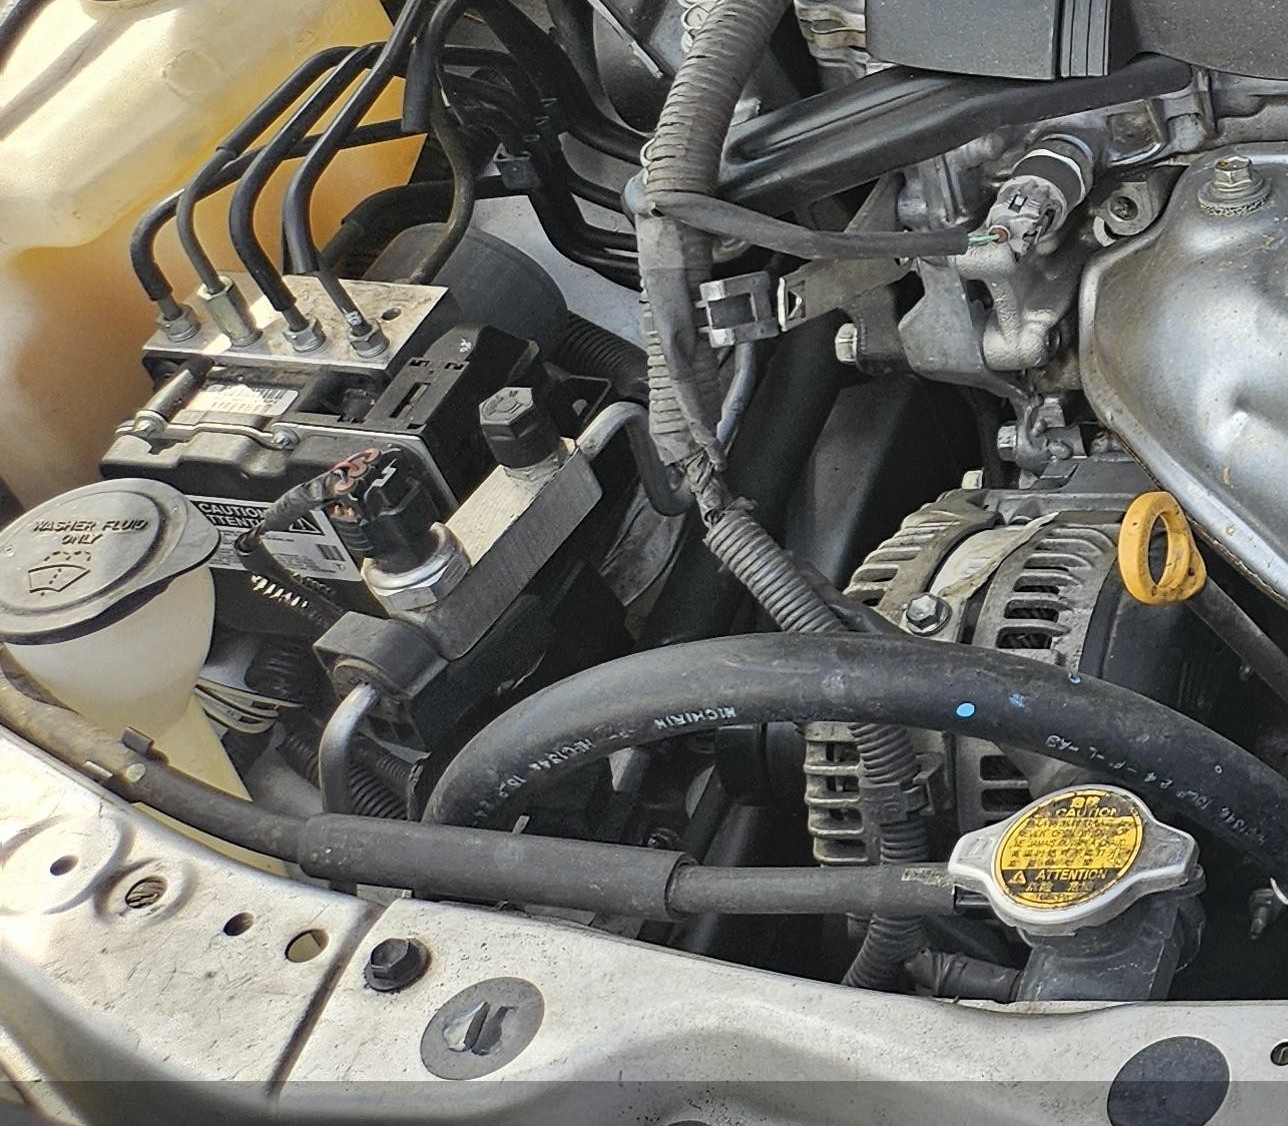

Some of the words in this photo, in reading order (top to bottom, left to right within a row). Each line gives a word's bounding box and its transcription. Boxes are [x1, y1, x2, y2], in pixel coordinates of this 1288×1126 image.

[33, 520, 96, 532] WASHER
[102, 519, 149, 531] FLUID
[61, 534, 103, 545] ONLY
[1035, 869, 1108, 880] ATTENTION
